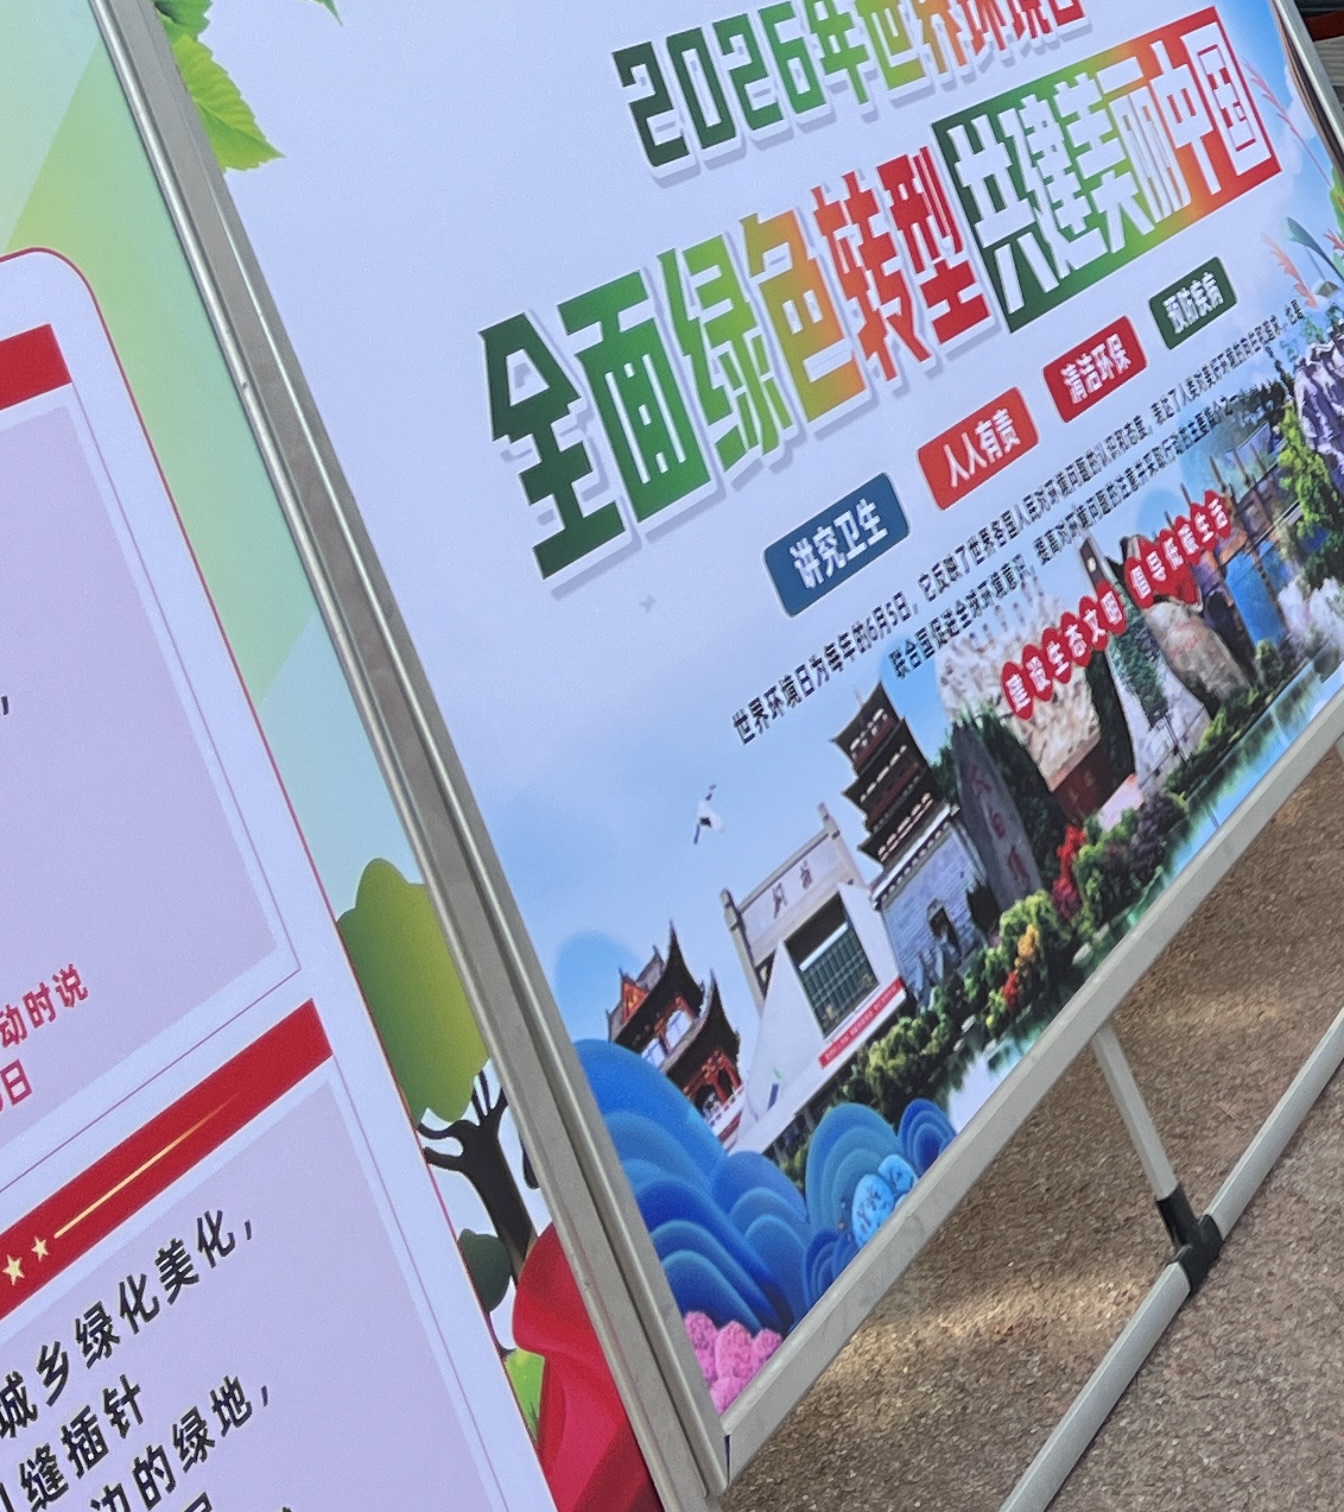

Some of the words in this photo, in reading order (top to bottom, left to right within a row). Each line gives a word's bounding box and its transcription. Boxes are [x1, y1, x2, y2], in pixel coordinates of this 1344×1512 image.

[478, 145, 992, 579] 全面绿色转型
[945, 22, 1270, 315] 共建美丽中国
[789, 498, 889, 589] 讲究卫生
[944, 407, 1021, 490] 人人有责
[1060, 333, 1132, 405] 清洁环保
[1162, 271, 1224, 335] 预防疾病
[1004, 589, 1125, 713] 建设生态文明
[1130, 497, 1230, 600] 倡导低碳生活
[0, 963, 88, 1048] 动时说
[0, 1374, 143, 1512] 缝插针
